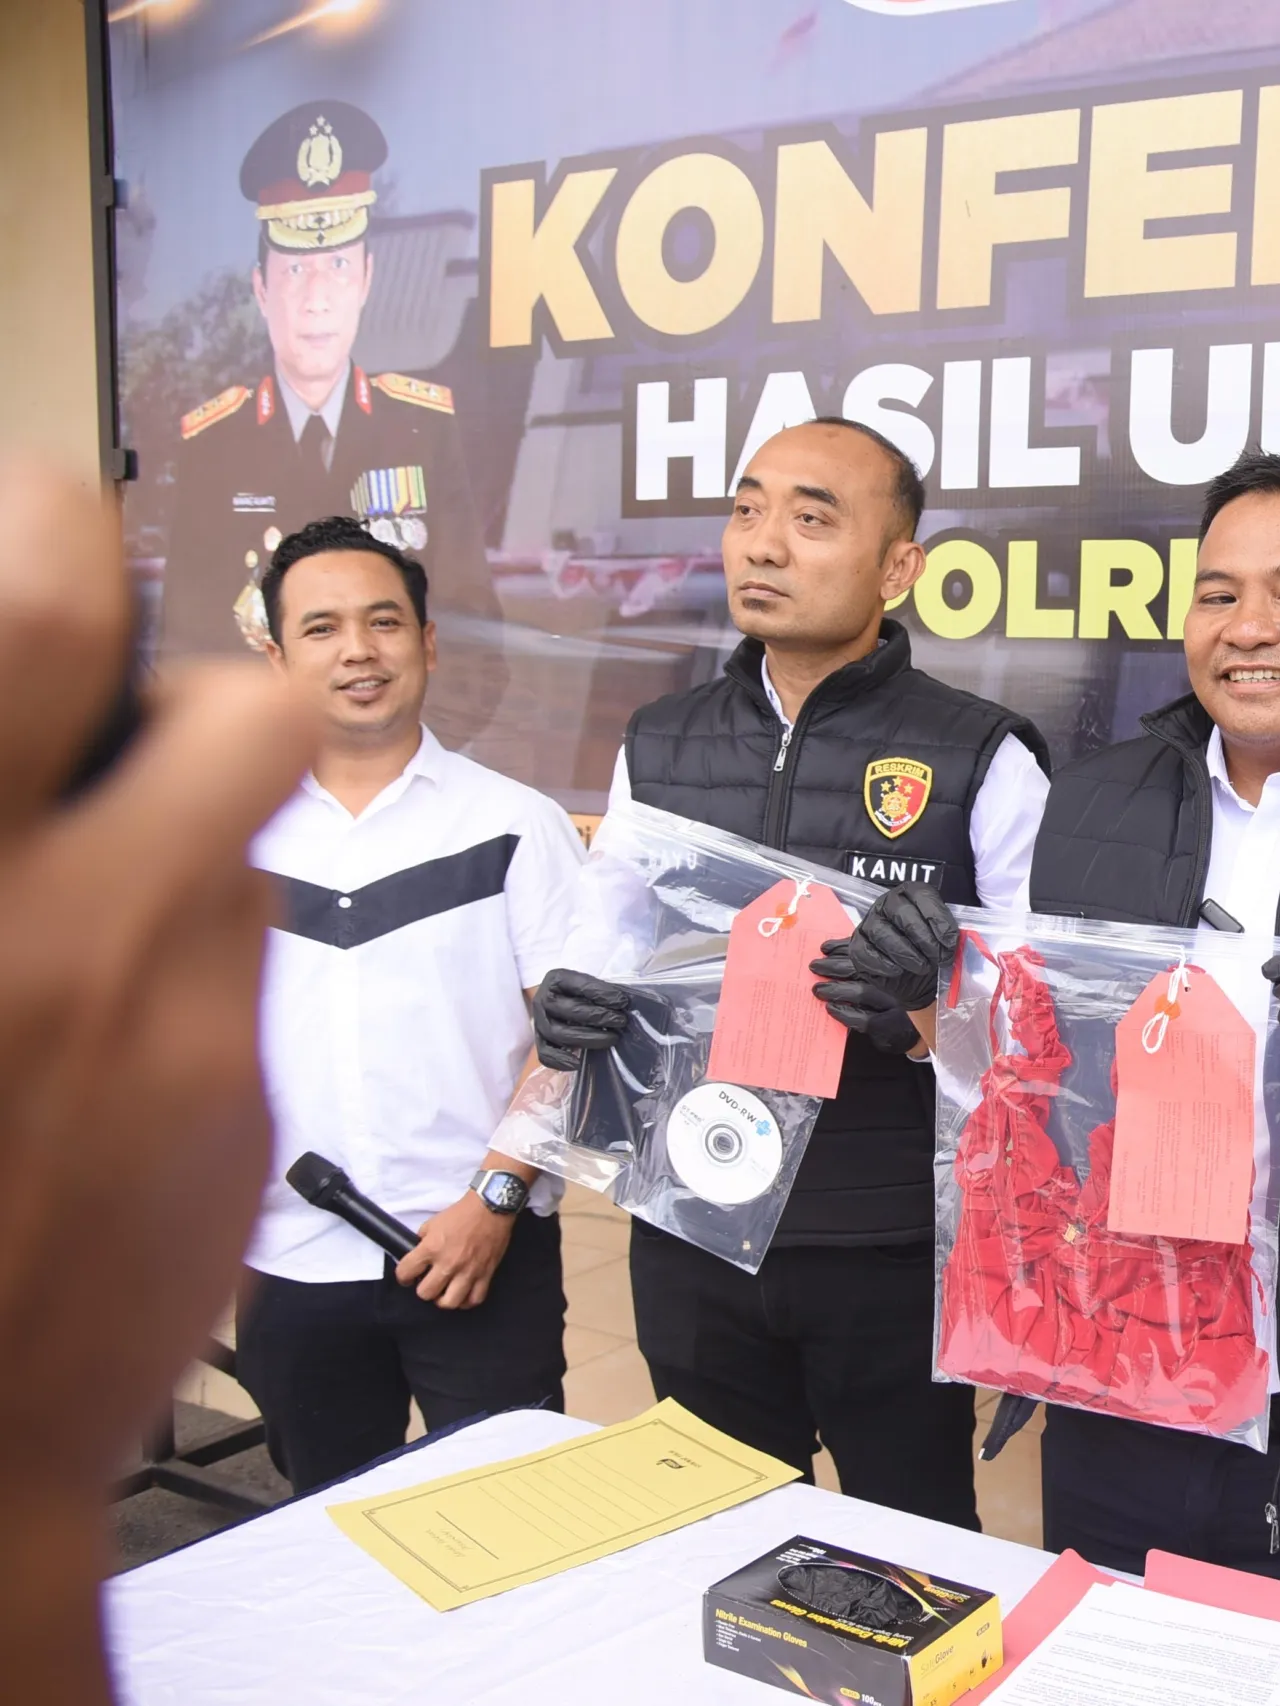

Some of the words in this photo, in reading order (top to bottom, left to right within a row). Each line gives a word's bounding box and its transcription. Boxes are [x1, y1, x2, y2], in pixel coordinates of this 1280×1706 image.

[883, 537, 1199, 640] OLR
[874, 763, 925, 777] RESKRIM
[852, 856, 936, 883] KANIT
[718, 1090, 757, 1123] DVD-RW
[715, 1608, 738, 1624] Nitrile
[738, 1616, 782, 1639] Examination
[782, 1631, 808, 1648] Gloves
